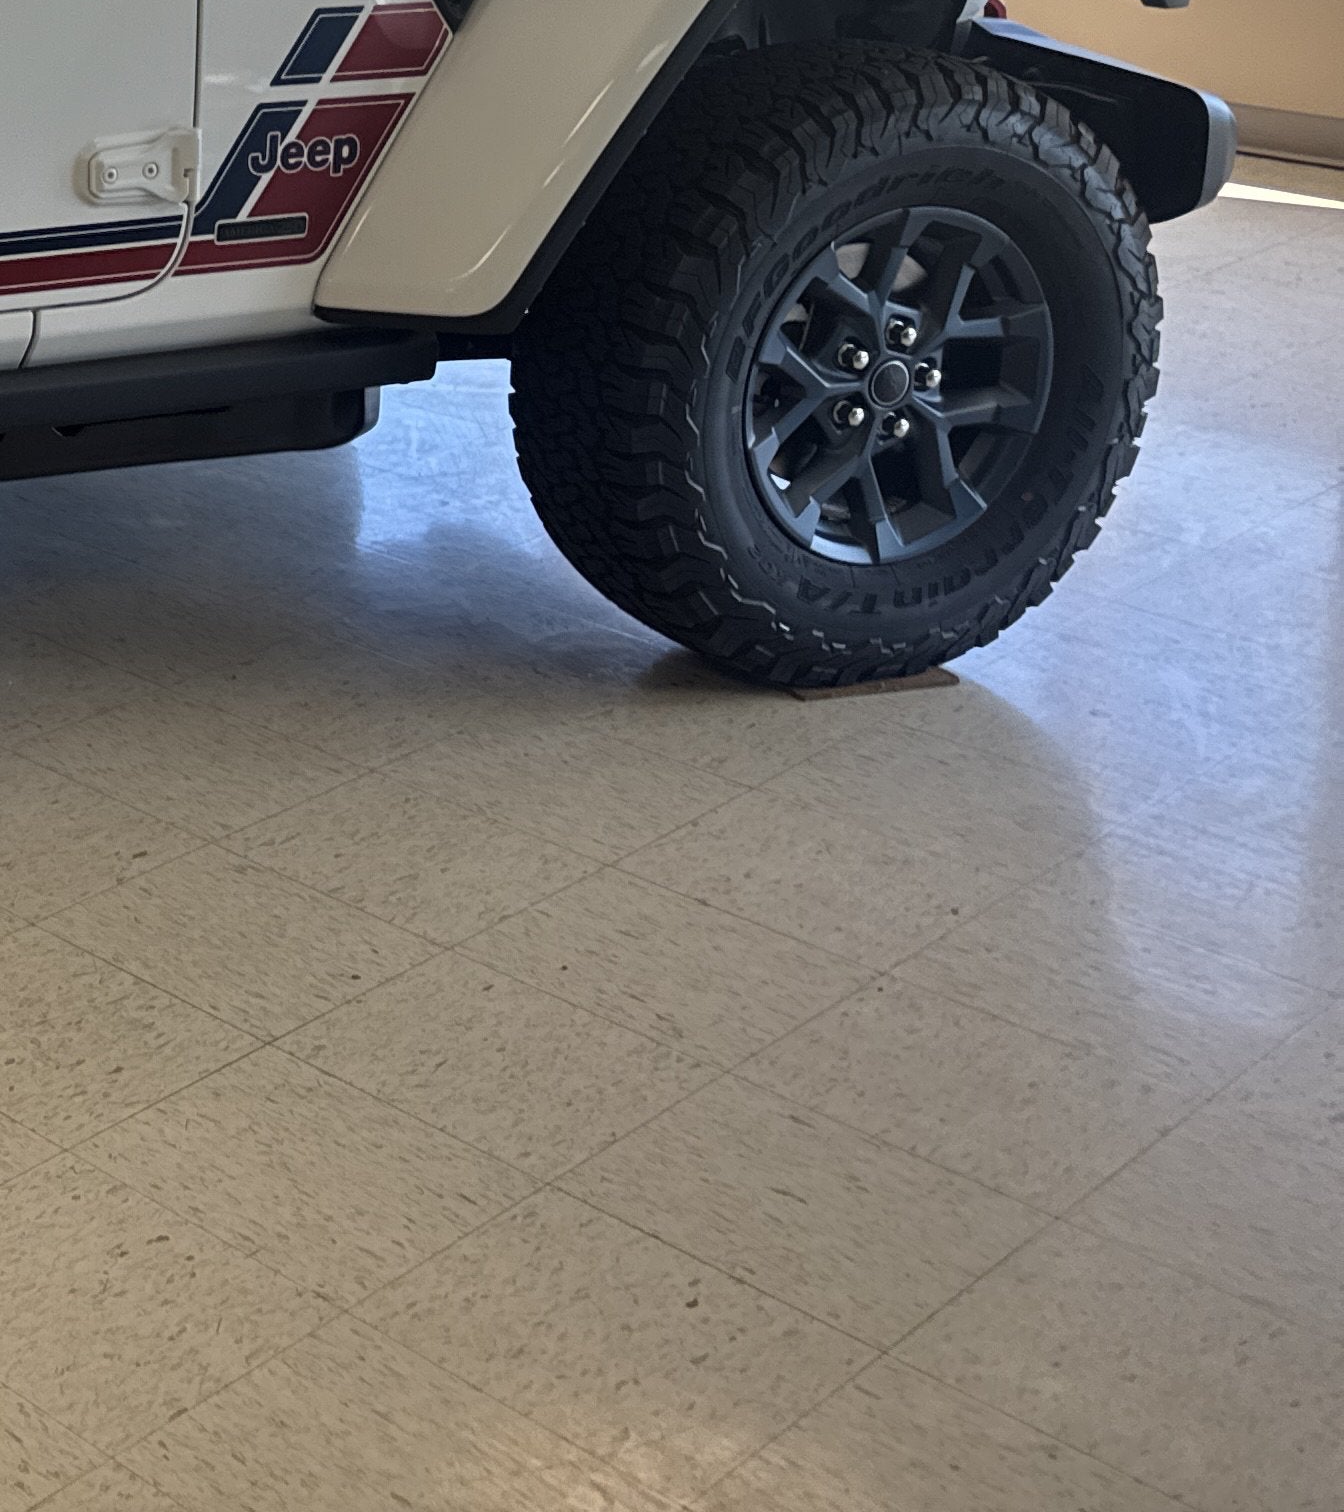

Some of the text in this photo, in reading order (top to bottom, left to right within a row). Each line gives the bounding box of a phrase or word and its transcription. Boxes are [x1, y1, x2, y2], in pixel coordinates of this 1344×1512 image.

[248, 131, 360, 177] Jeep
[726, 167, 1006, 384] BFGoodrich
[796, 575, 879, 615] T/A
